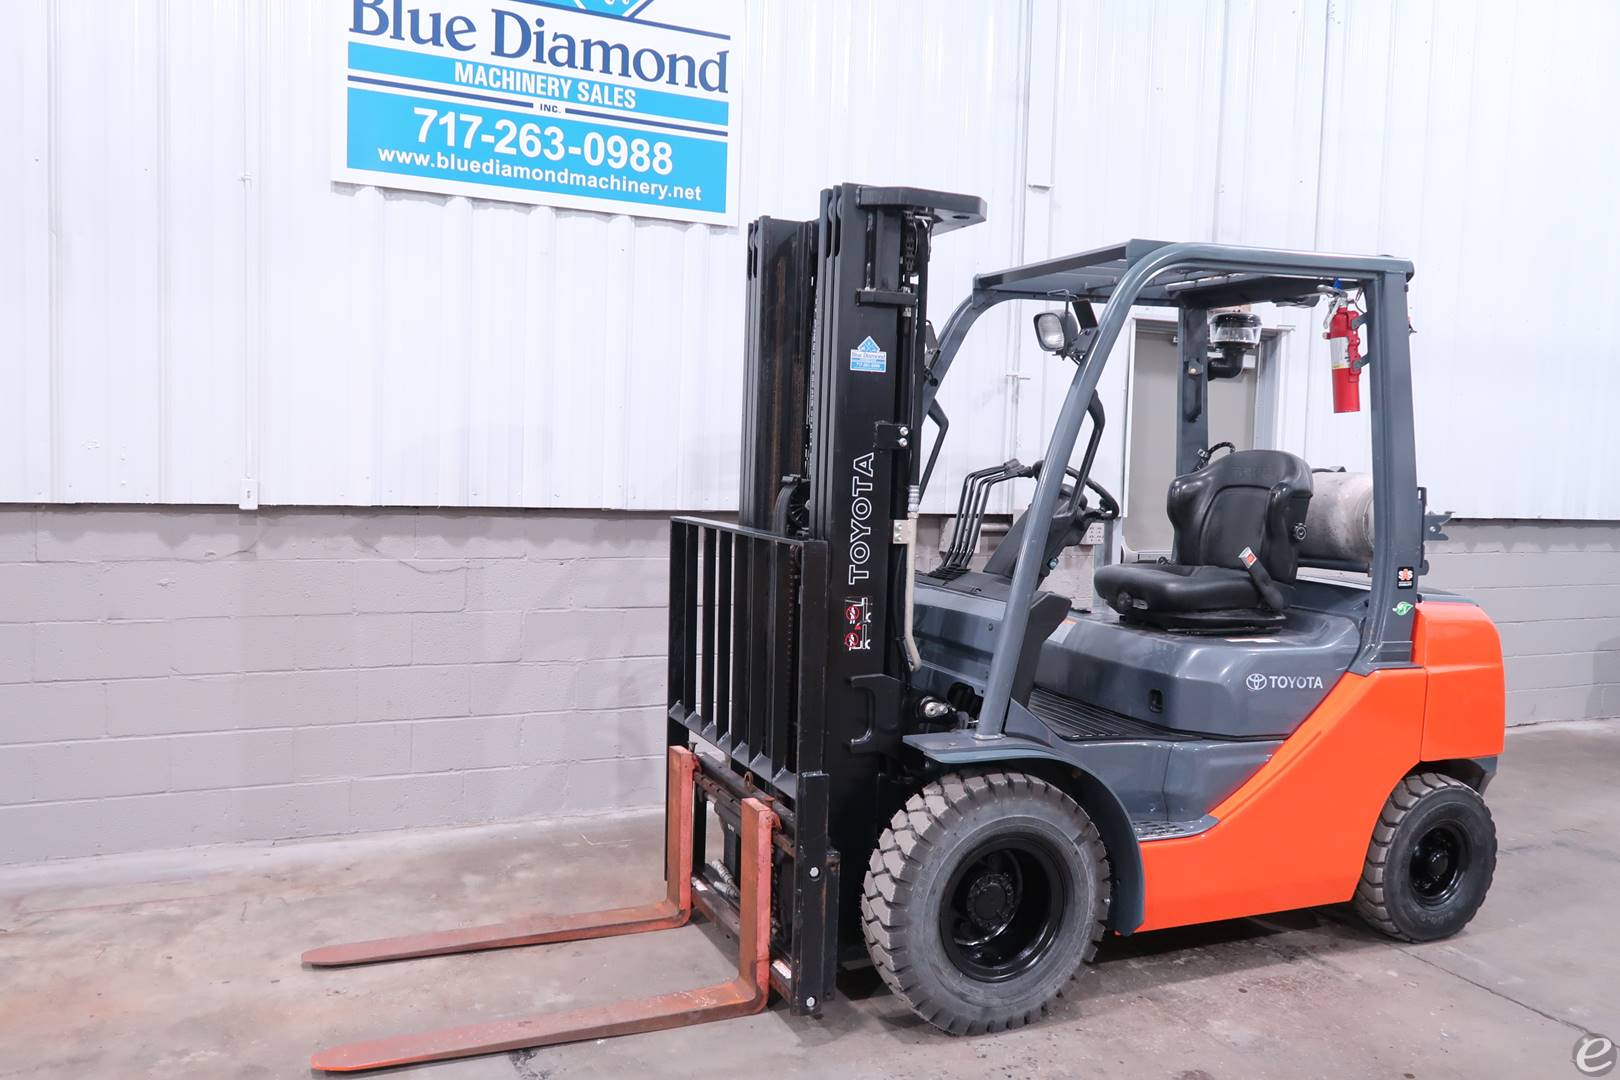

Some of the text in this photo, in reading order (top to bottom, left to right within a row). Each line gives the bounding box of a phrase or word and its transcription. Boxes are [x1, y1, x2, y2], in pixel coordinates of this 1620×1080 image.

[349, 0, 729, 94] Blue Diamond
[454, 61, 636, 109] MACHINERY SALES
[540, 102, 562, 114] INC.
[413, 106, 673, 176] 717-263-0988
[378, 147, 702, 201] www.bluediamondmachinery.net
[849, 452, 874, 585] TOYOTA
[1269, 675, 1323, 689] TOYOTA
